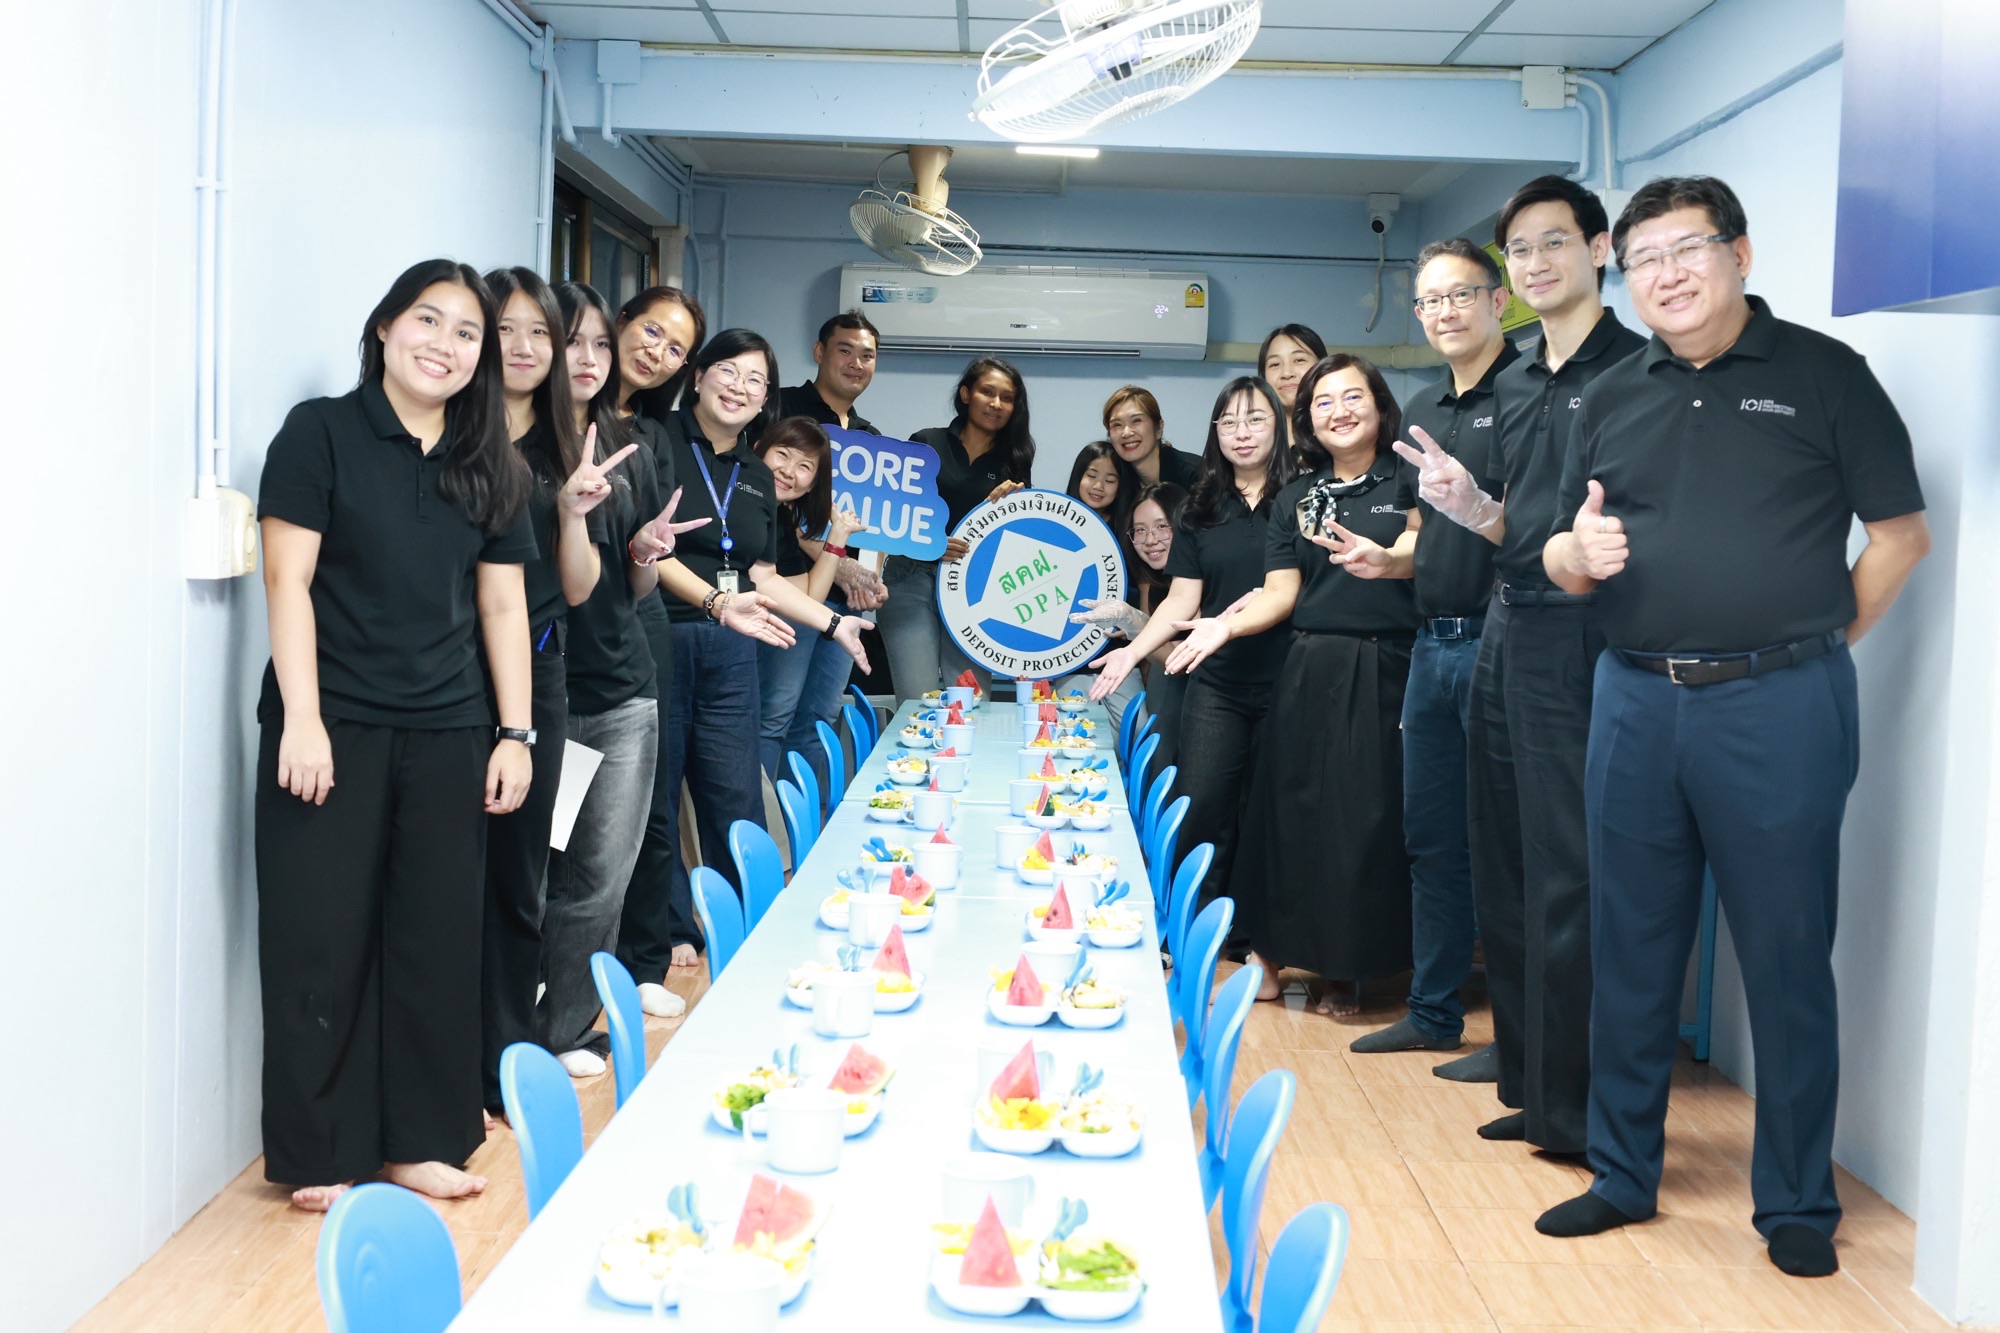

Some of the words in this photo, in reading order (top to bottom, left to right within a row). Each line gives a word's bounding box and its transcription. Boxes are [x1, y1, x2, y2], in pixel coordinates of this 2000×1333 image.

[831, 489, 934, 545] ALUE
[960, 625, 1017, 669] DEPOSIT
[1102, 554, 1118, 600] ENCY
[1014, 585, 1070, 625] DPA
